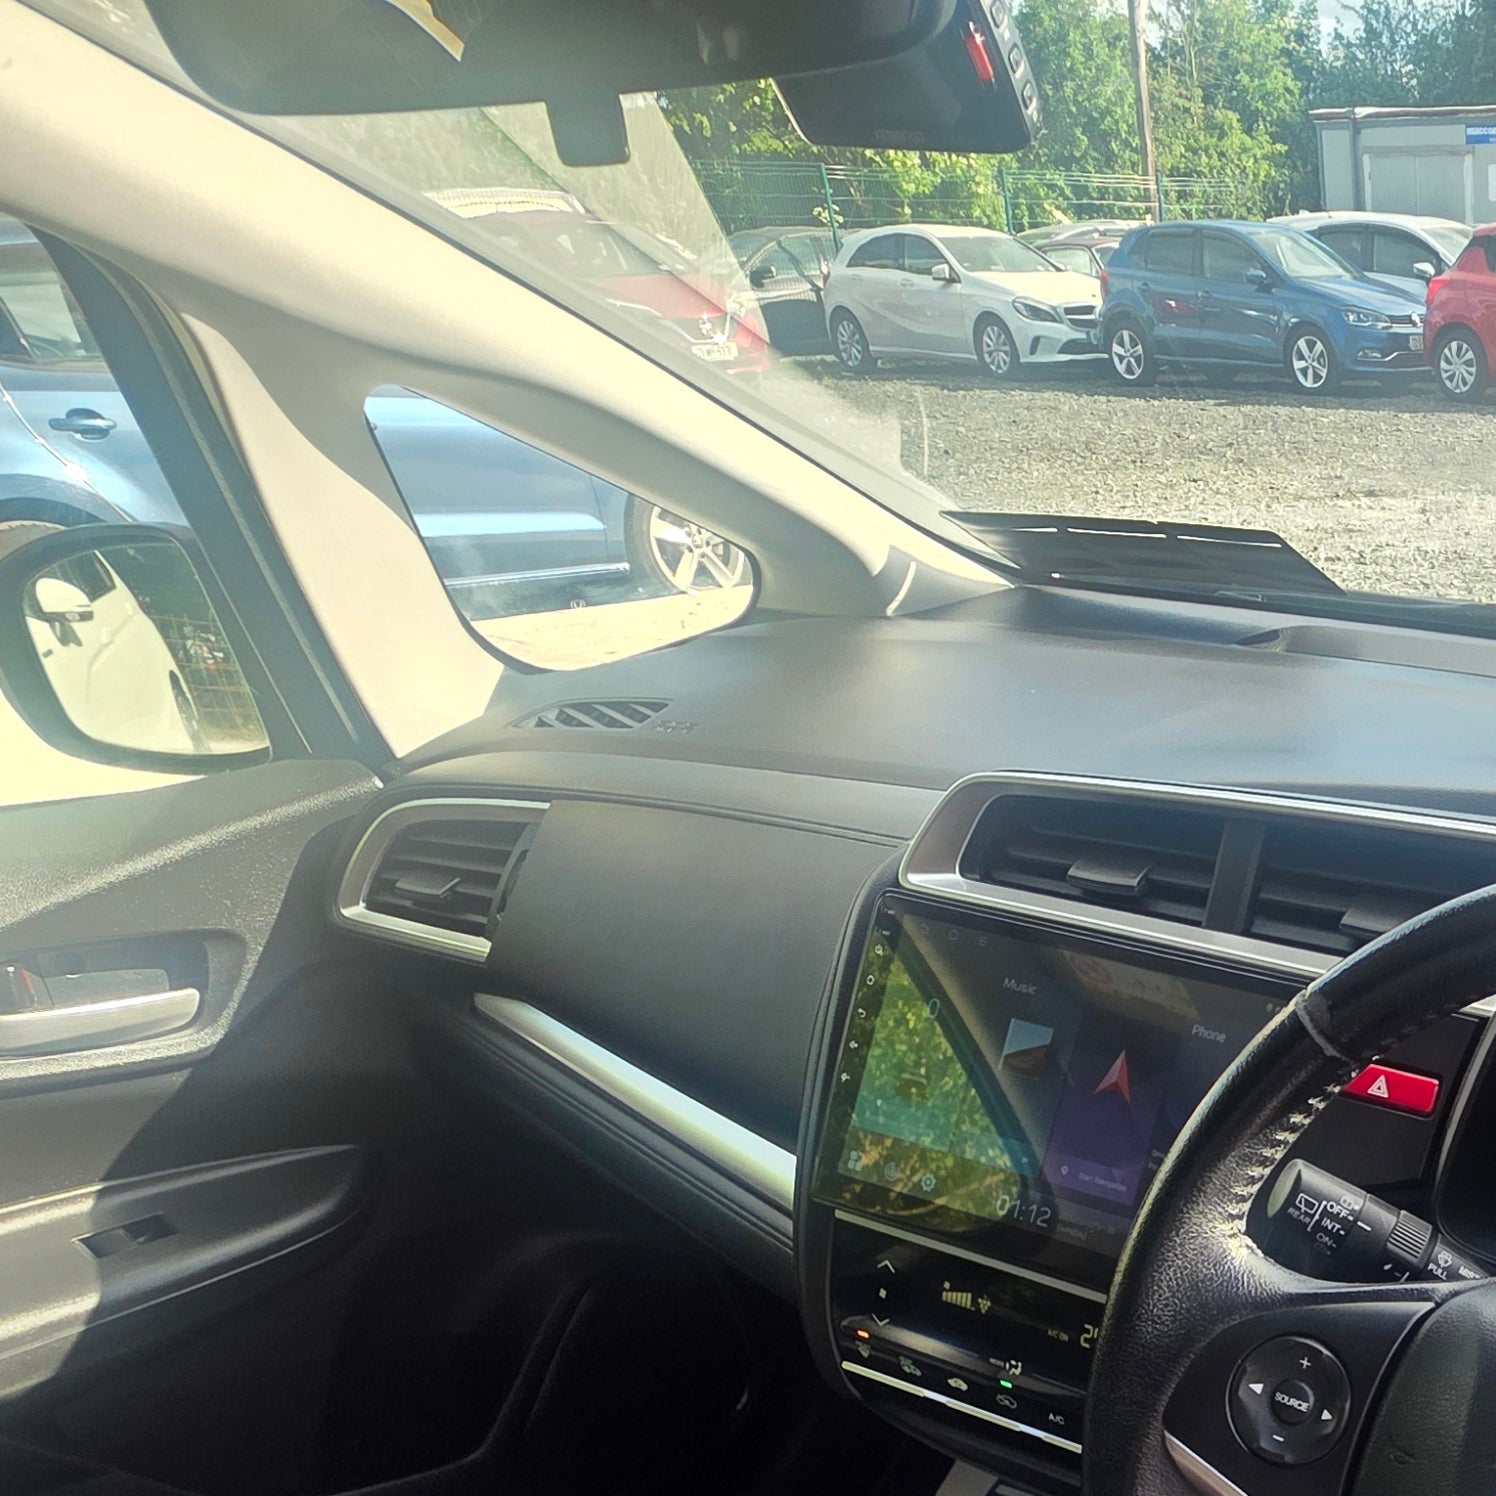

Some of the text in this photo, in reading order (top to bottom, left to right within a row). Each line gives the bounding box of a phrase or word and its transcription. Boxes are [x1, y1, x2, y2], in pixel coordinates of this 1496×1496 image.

[1003, 977, 1039, 996] Music
[1191, 1024, 1227, 1043] Phone
[995, 1194, 1052, 1228] 01:12
[1287, 1206, 1312, 1226] REAR
[1326, 1200, 1350, 1220] OFF
[1321, 1217, 1341, 1234] INT
[1315, 1231, 1333, 1247] ON
[1427, 1262, 1448, 1281] PULL
[1274, 1391, 1310, 1413] SOURCE
[1048, 1412, 1065, 1425] A/C
